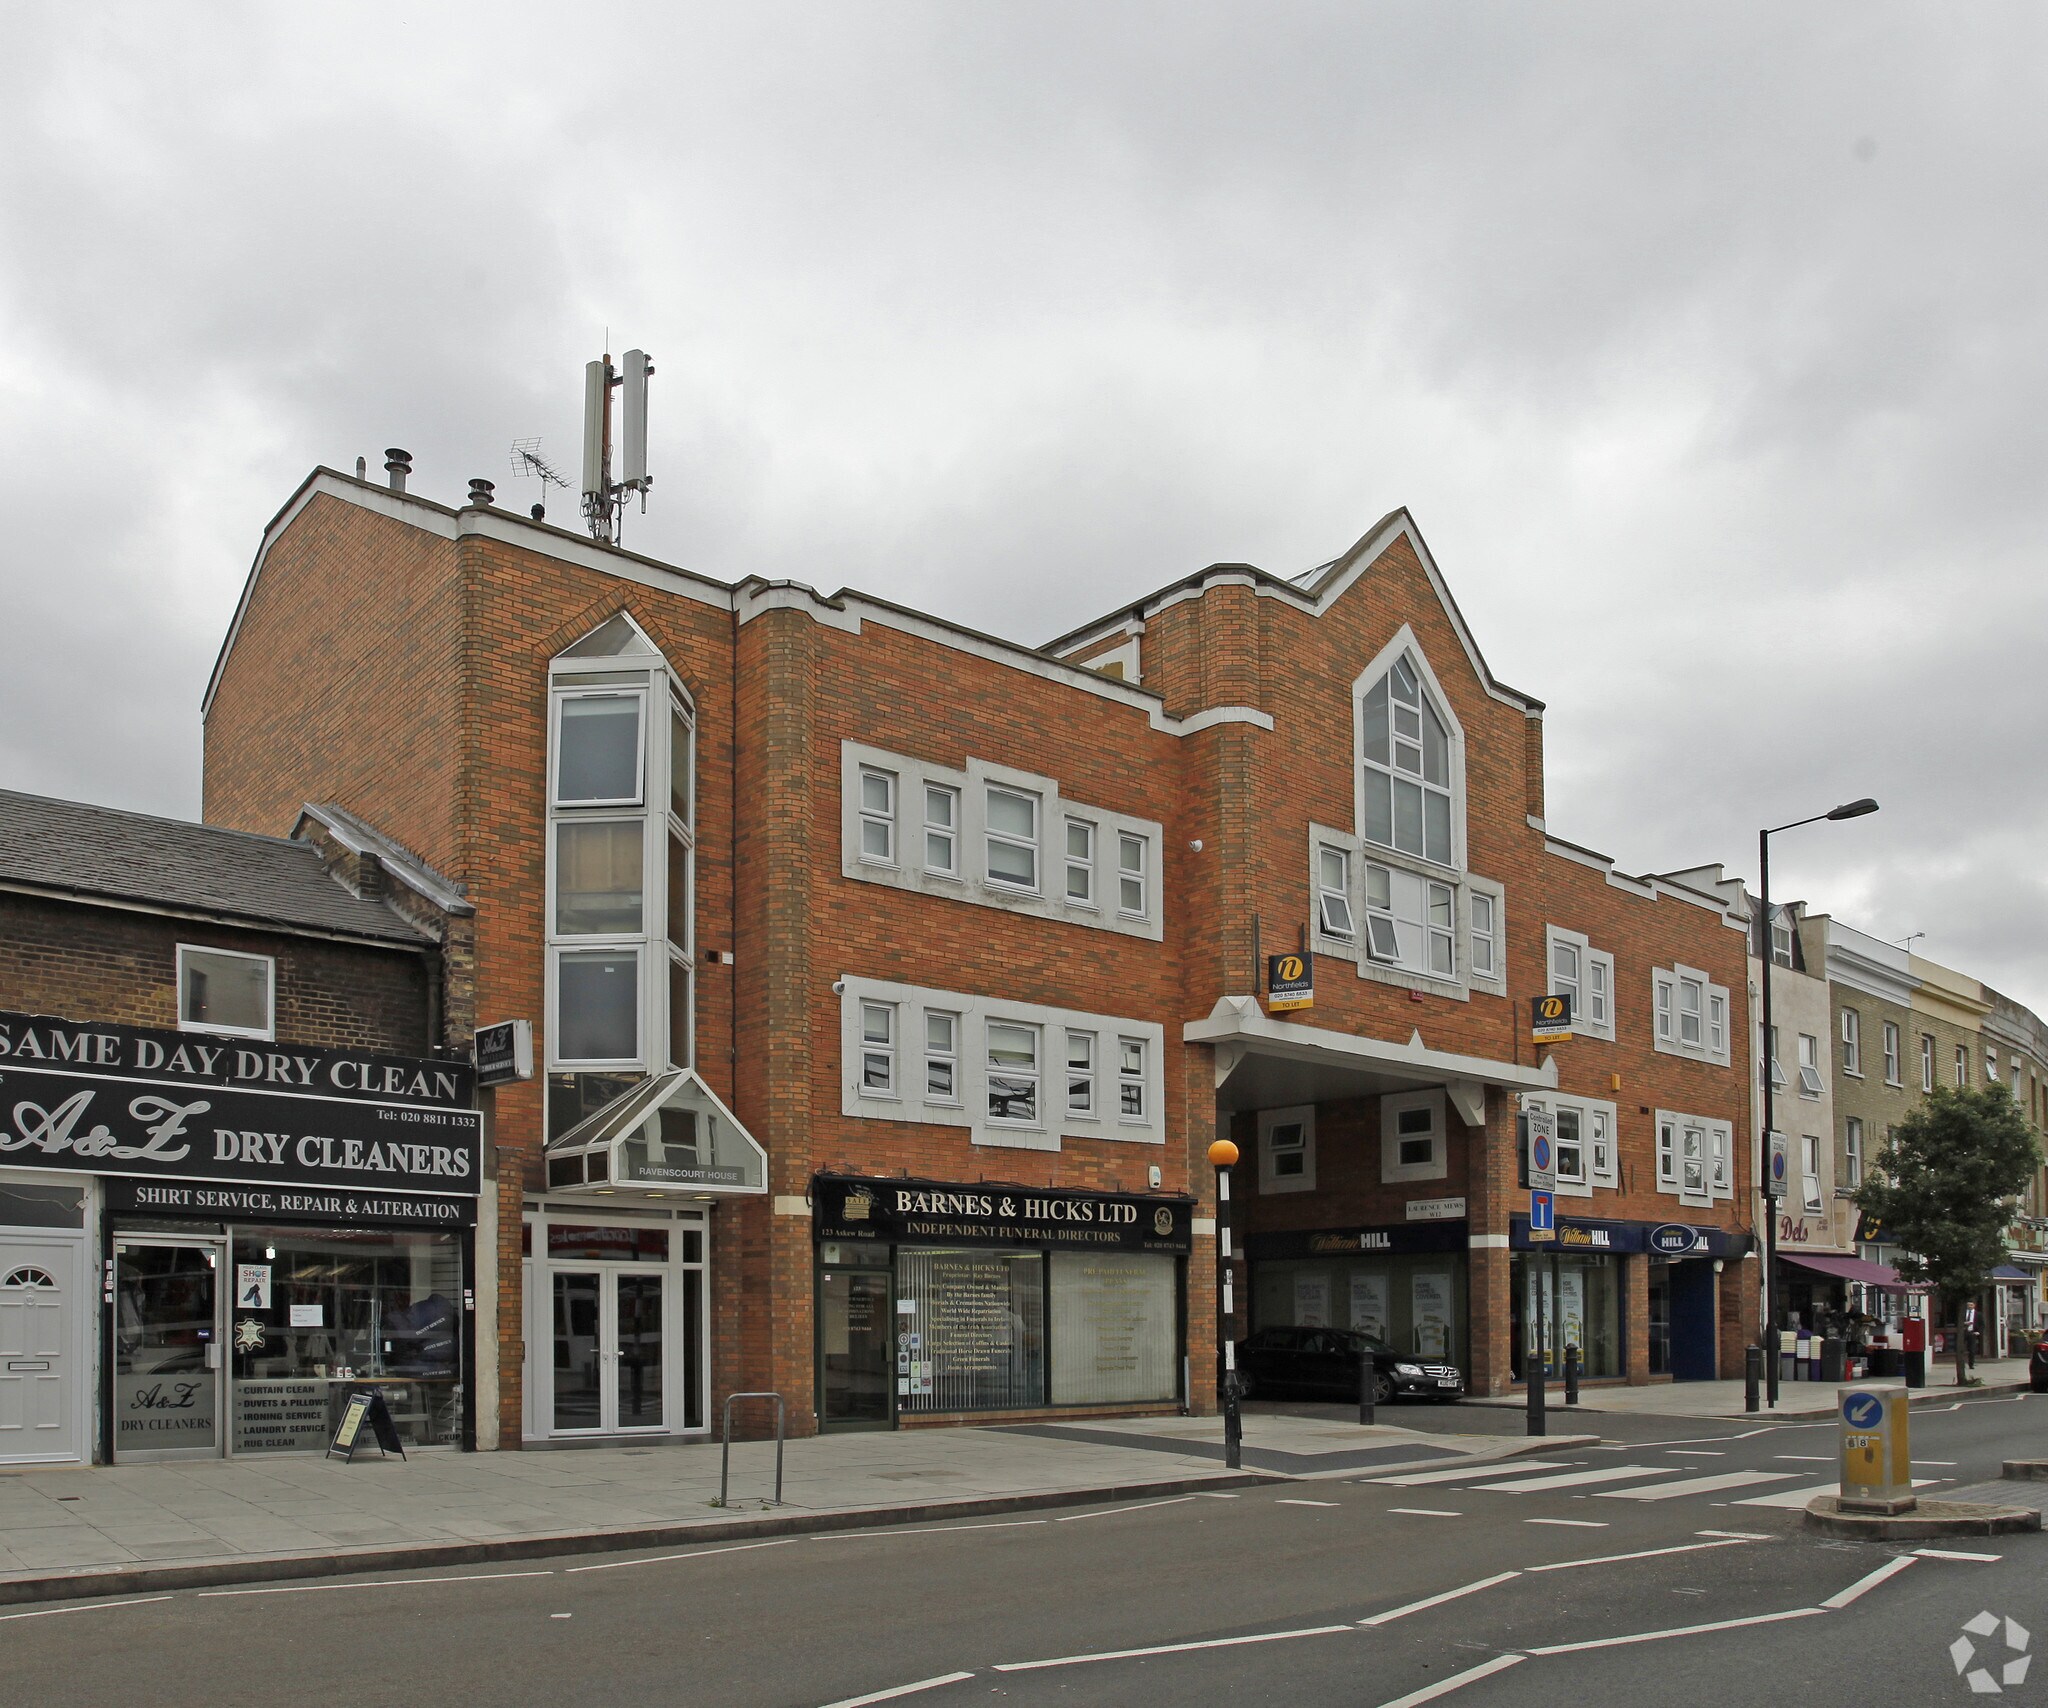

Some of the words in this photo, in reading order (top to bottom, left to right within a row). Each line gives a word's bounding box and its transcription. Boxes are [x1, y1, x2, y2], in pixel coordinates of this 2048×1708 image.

[1272, 981, 1309, 990] Northfields
[1535, 1018, 1568, 1026] Northfields
[0, 1023, 122, 1066] SAME
[134, 1038, 224, 1076] DAY
[235, 1049, 321, 1086] DRY
[330, 1060, 458, 1100] CLEAN
[376, 1109, 397, 1121] Tel:
[401, 1112, 420, 1123] 020
[423, 1113, 447, 1125] 8811
[451, 1116, 476, 1127] 1332
[1530, 1112, 1553, 1125] Controlled
[1533, 1122, 1550, 1135] ZONE
[213, 1128, 290, 1165] DRY
[296, 1135, 470, 1177] CLEANERS
[639, 1167, 706, 1179] RAVENSCOURT
[708, 1171, 737, 1180] HOUSE
[136, 1186, 193, 1206] SHIRT
[196, 1190, 277, 1212] SERVICE,
[280, 1195, 342, 1213] REPAIR
[345, 1199, 358, 1214] &
[361, 1199, 461, 1219] ALTERATION
[895, 1190, 992, 1216] BARNES
[999, 1197, 1017, 1218] &
[1024, 1199, 1093, 1221] HICKS
[1098, 1203, 1138, 1224] LTD
[821, 1228, 833, 1236] 123
[835, 1229, 856, 1237] Askew
[857, 1230, 876, 1238] Road
[907, 1222, 995, 1238] INDEPENDENT
[1000, 1226, 1056, 1240] FUNERAL
[1057, 1229, 1121, 1243] DIRECTORS
[1780, 1215, 1808, 1242] Dels
[1361, 1232, 1391, 1249] HILL
[1559, 1225, 1592, 1244] William
[1592, 1230, 1610, 1246] HILL
[1661, 1236, 1684, 1247] HILL
[243, 1269, 267, 1278] SHOE
[933, 1263, 963, 1271] BARNES
[243, 1386, 283, 1395] CURTAIN
[286, 1386, 315, 1394] CLEAN
[243, 1399, 277, 1408] DUVETS
[280, 1399, 288, 1407] &
[290, 1399, 329, 1407] PILLOWS
[243, 1412, 283, 1421] IRONING
[285, 1411, 322, 1420] SERVICE
[121, 1419, 146, 1431] DRY
[149, 1418, 212, 1431] CLEANERS
[243, 1425, 287, 1435] LAUNDRY
[289, 1424, 326, 1433] SERVICE
[244, 1439, 263, 1448] RUG
[265, 1438, 295, 1447] CLEAN
